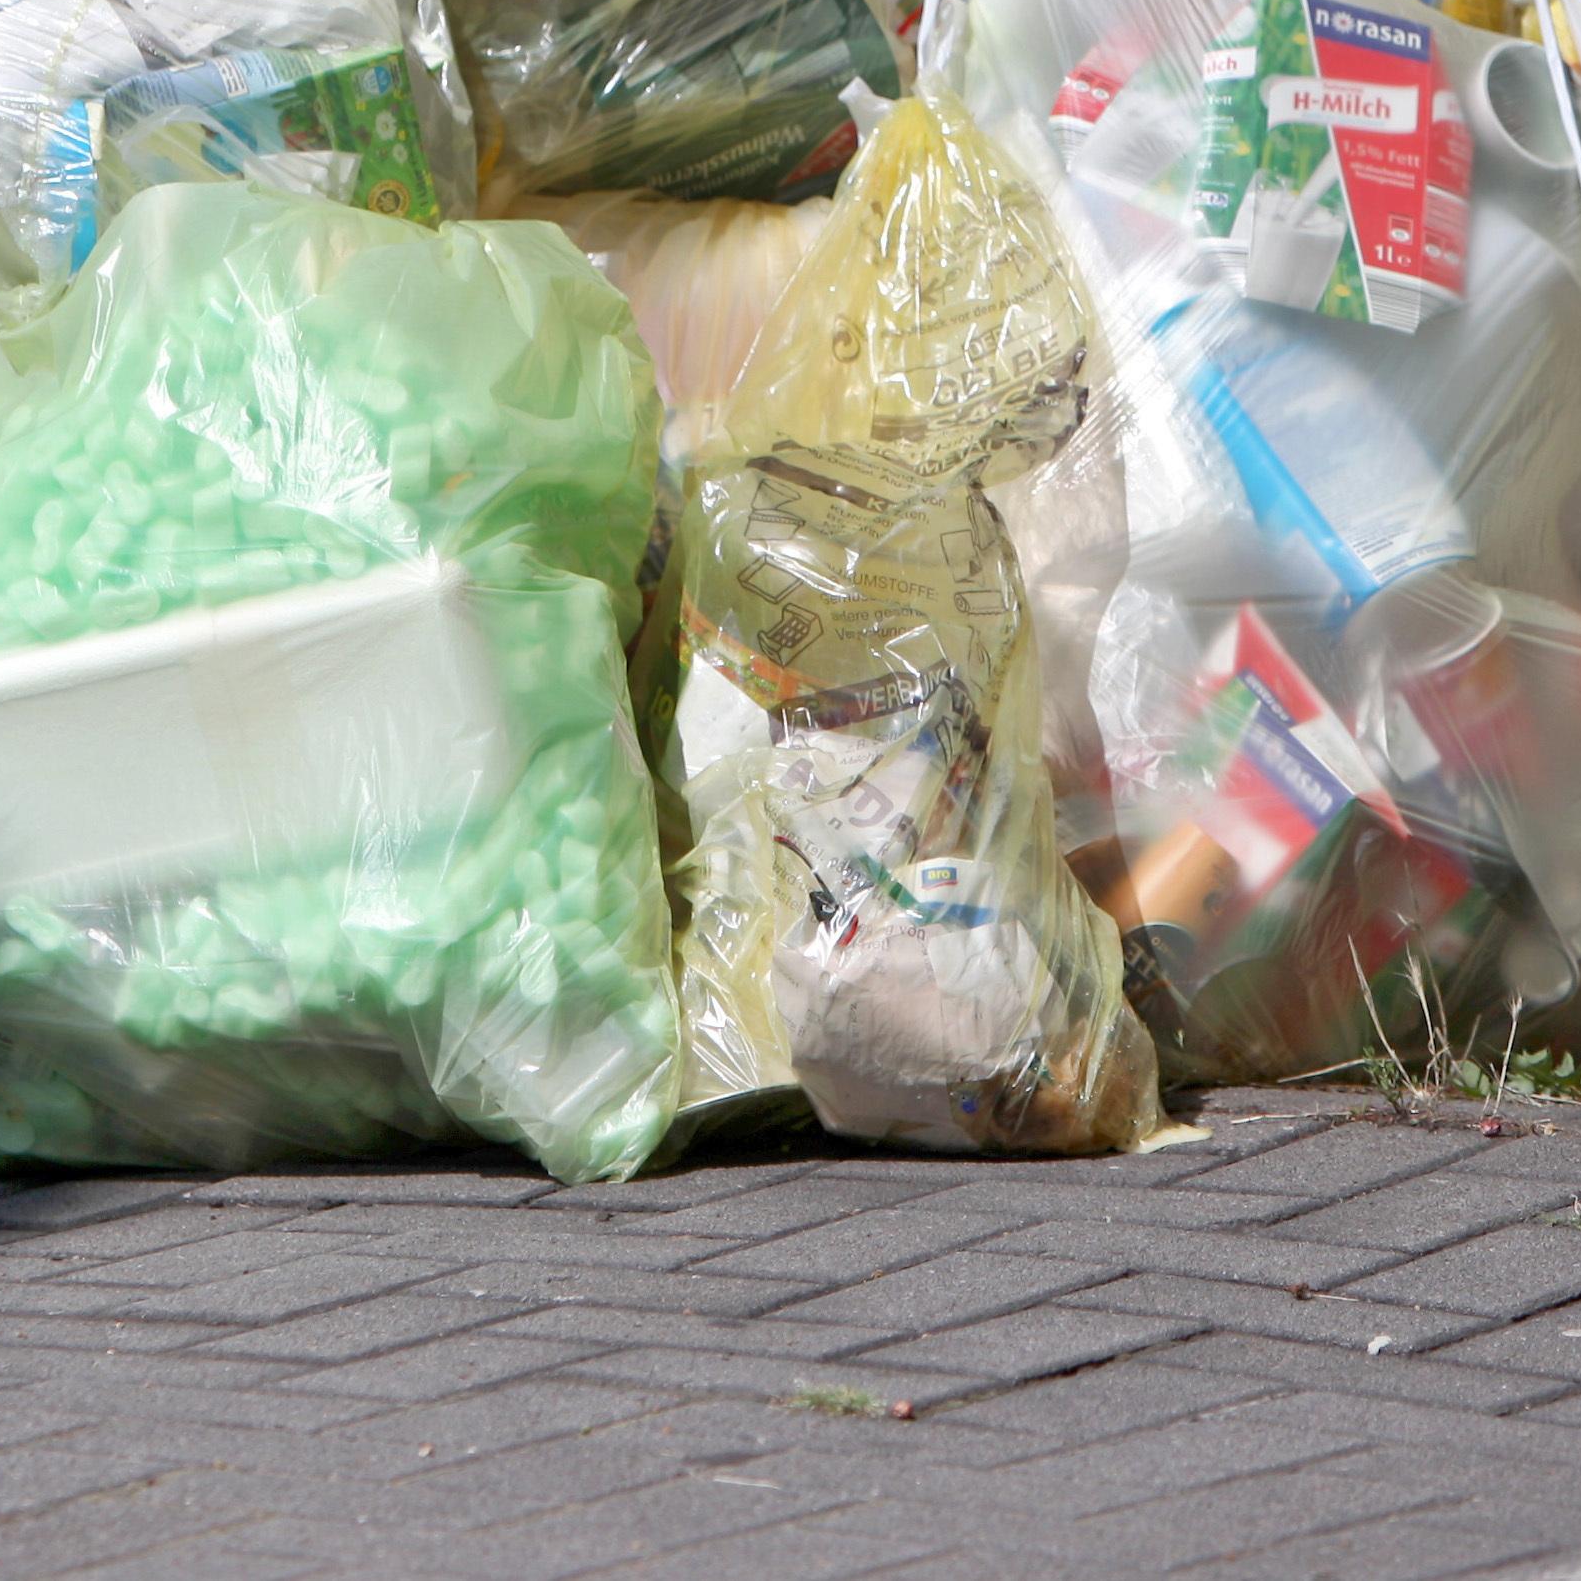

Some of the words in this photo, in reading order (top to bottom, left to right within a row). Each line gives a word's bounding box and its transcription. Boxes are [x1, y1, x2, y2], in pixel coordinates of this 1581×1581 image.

[1315, 7, 1422, 51] norasan
[1292, 90, 1392, 120] H-Milch
[1388, 149, 1421, 169] Fett
[926, 866, 952, 882] aro
